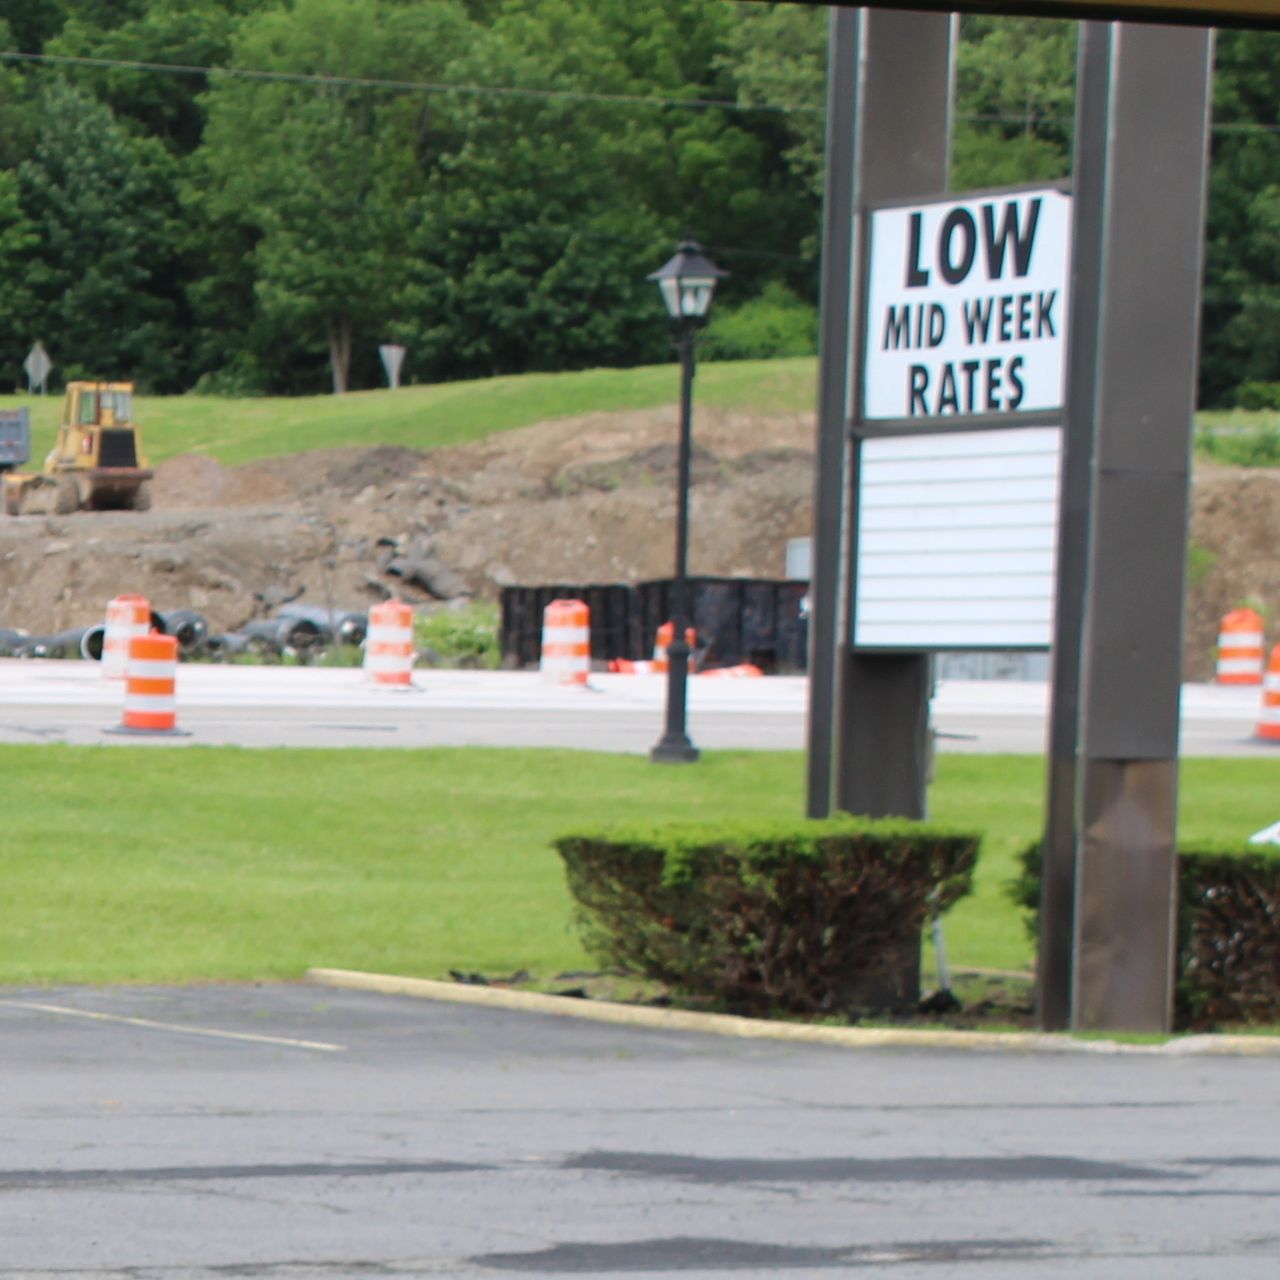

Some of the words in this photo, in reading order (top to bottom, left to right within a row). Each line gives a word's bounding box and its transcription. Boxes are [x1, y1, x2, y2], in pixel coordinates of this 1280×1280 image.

[905, 197, 1043, 288] LOW
[882, 303, 946, 351] MID
[962, 289, 1057, 345] WEEK
[906, 355, 1024, 417] RATES
